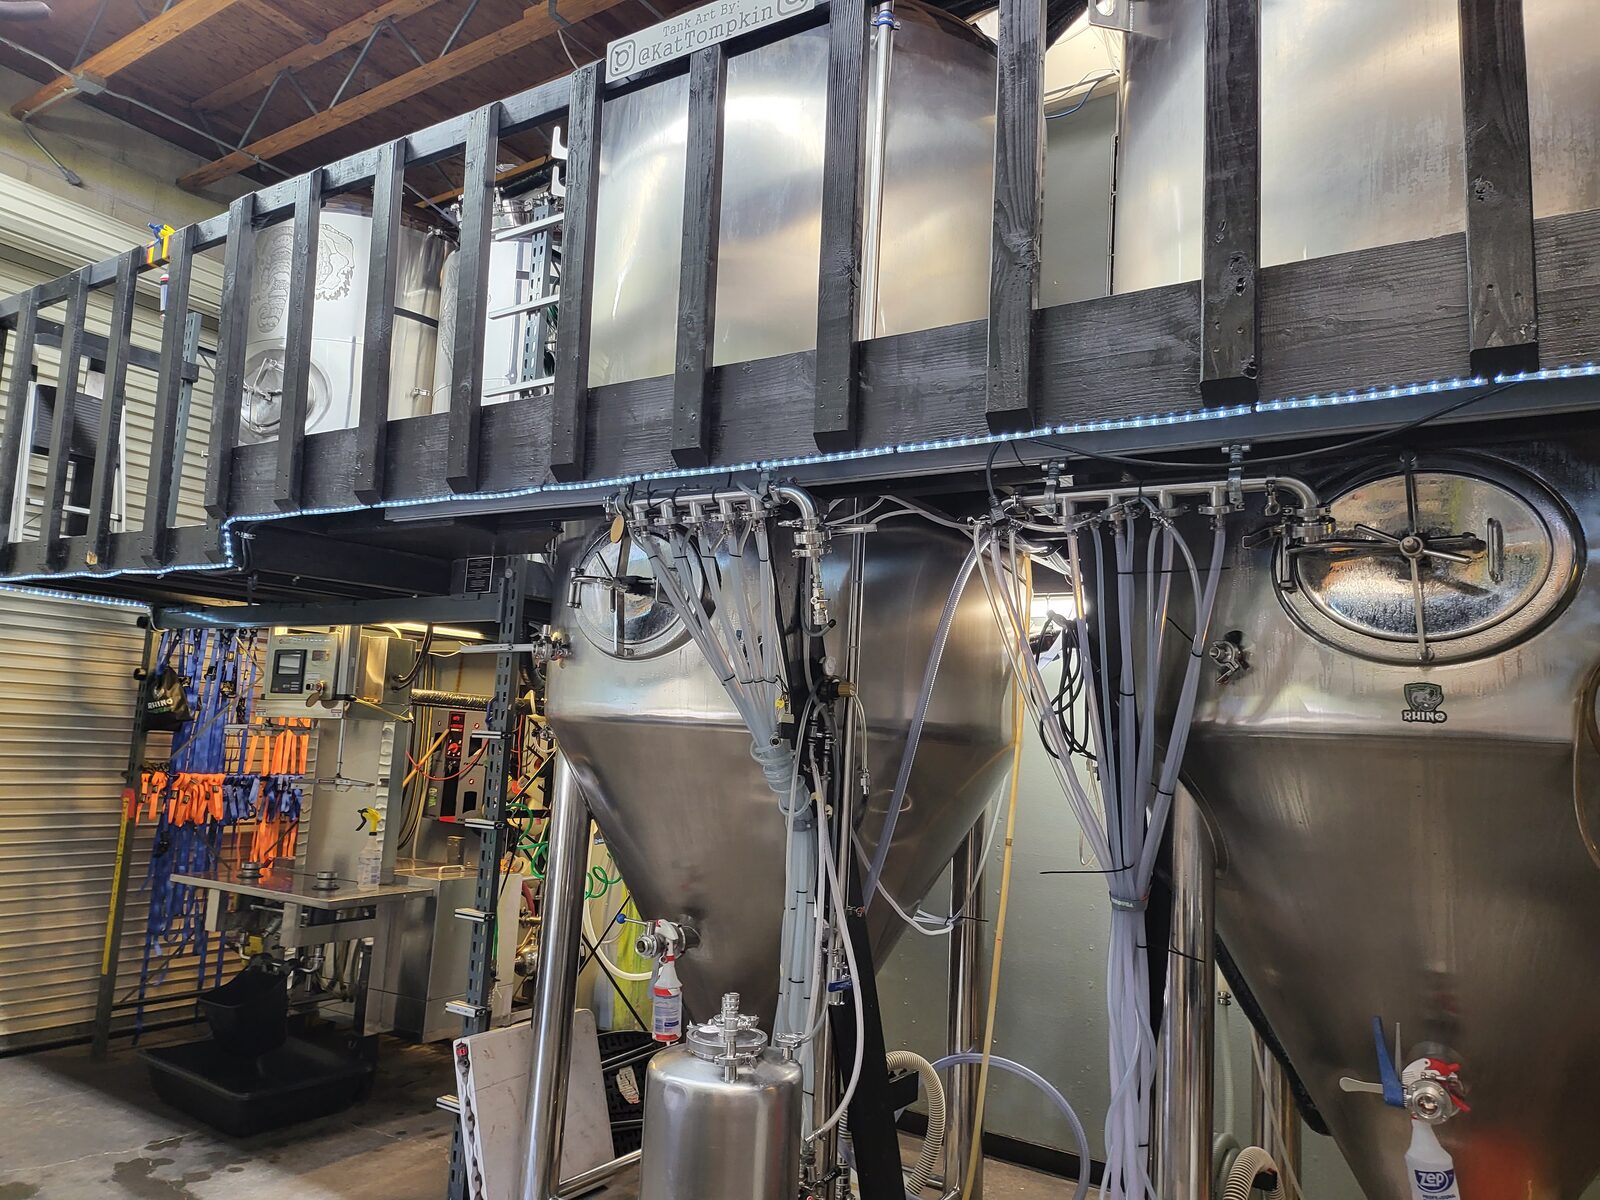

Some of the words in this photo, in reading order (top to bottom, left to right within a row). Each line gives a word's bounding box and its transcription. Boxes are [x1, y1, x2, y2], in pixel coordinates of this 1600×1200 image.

[662, 18, 692, 38] Tank
[695, 9, 716, 26] Art
[720, 1, 741, 17] By:
[638, 5, 774, 66] @KatTompkin
[147, 698, 173, 709] RHINO
[1403, 711, 1446, 721] RHINO
